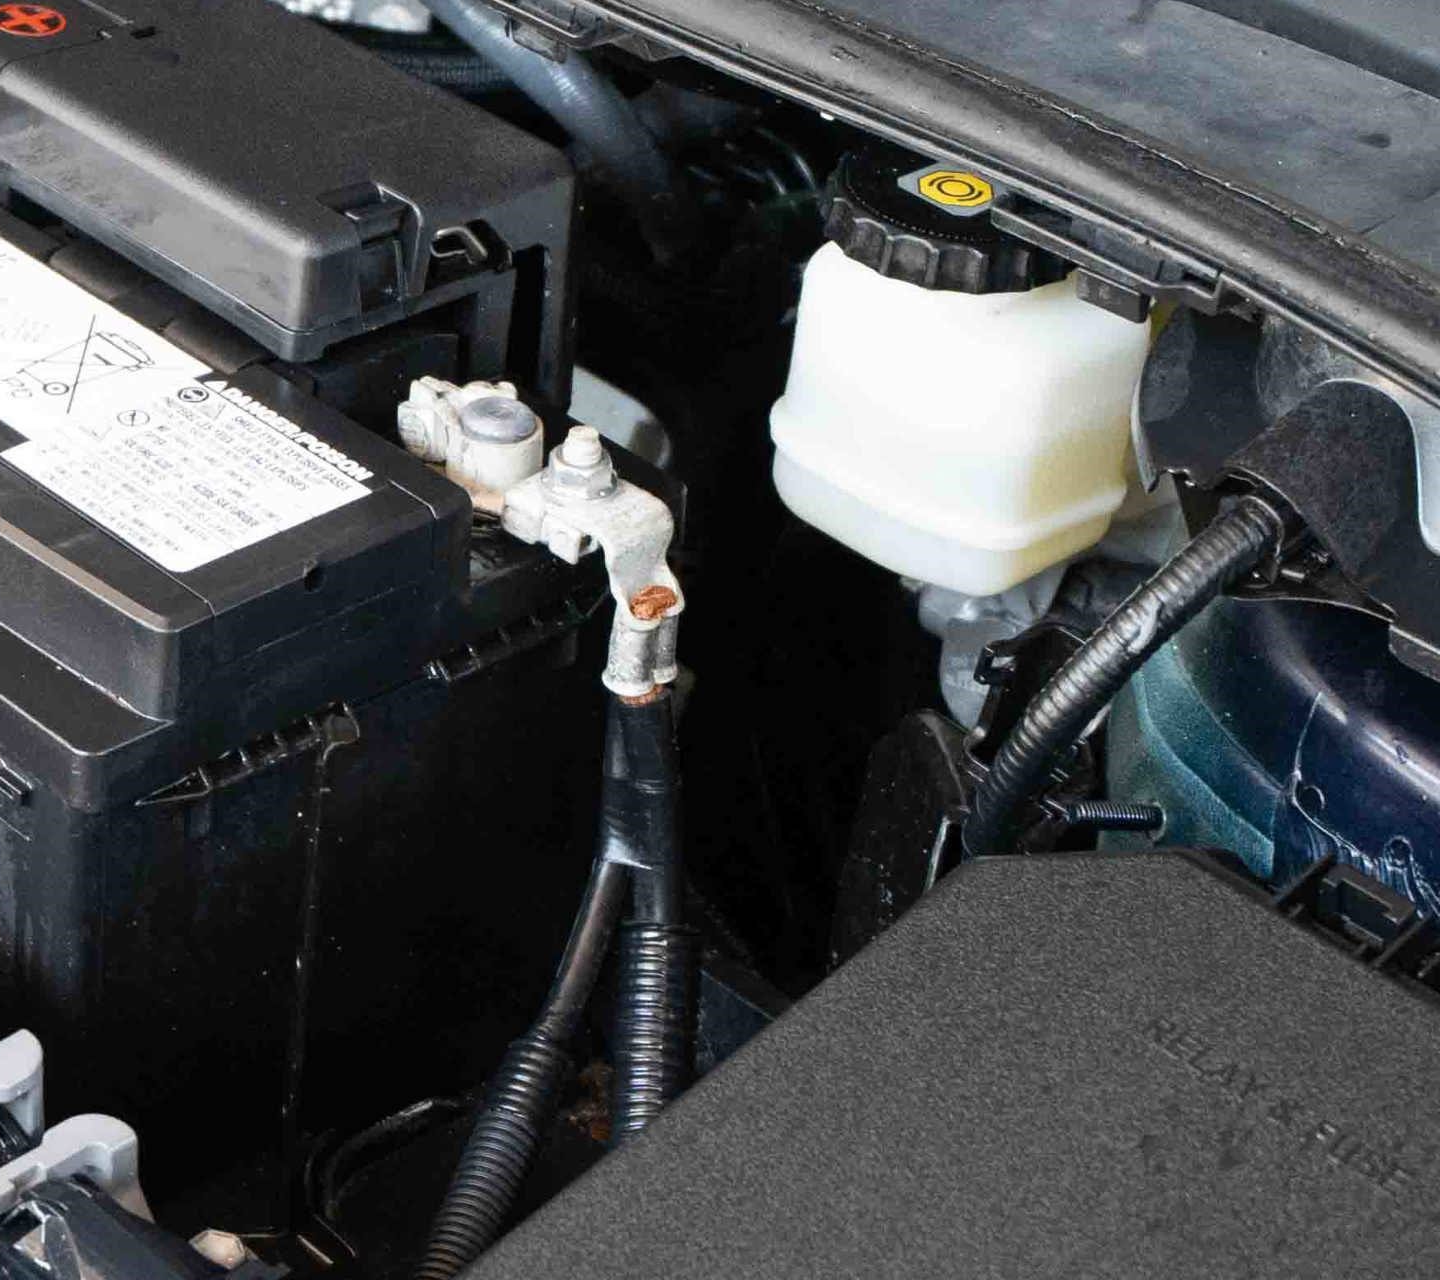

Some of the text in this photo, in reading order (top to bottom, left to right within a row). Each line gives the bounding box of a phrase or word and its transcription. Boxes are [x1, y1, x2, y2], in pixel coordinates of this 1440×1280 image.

[220, 386, 375, 482] DANGER/POISON
[1146, 1016, 1266, 1103] RELAY
[1301, 1120, 1415, 1194] FUSE
